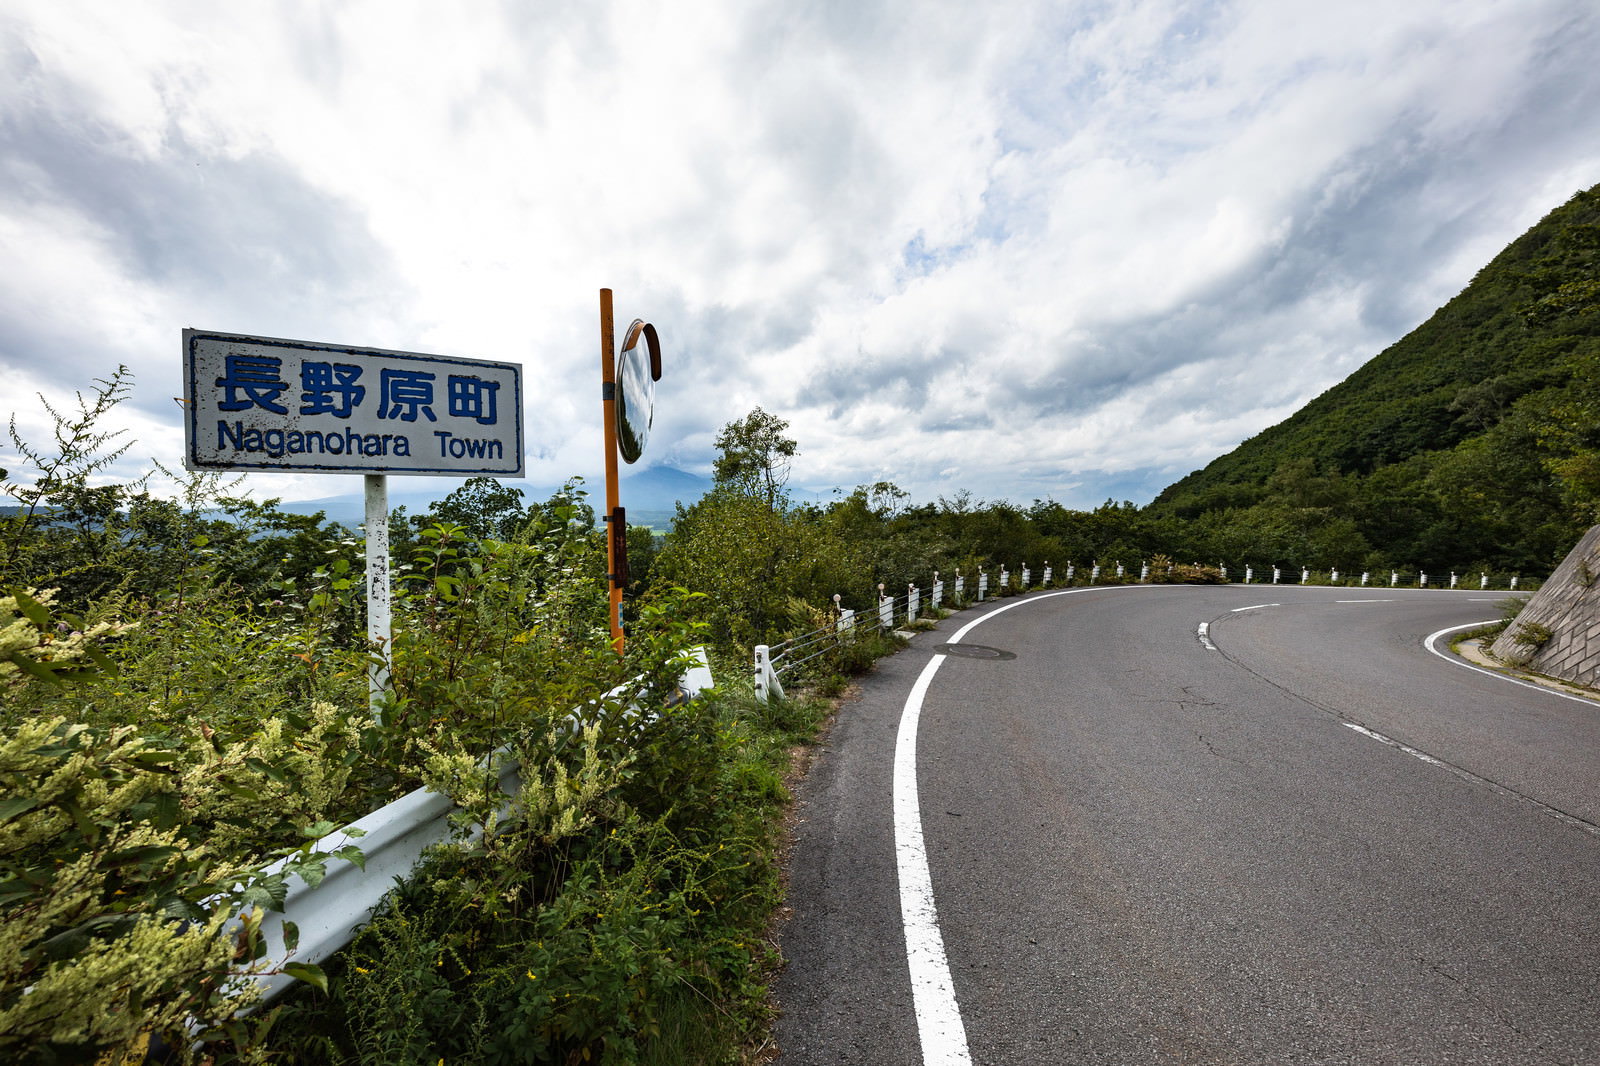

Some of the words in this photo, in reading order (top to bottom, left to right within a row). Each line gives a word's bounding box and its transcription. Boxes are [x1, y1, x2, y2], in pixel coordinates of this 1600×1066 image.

[216, 355, 500, 425] 長野原町
[218, 420, 411, 459] Naganohara
[434, 431, 503, 460] Town
